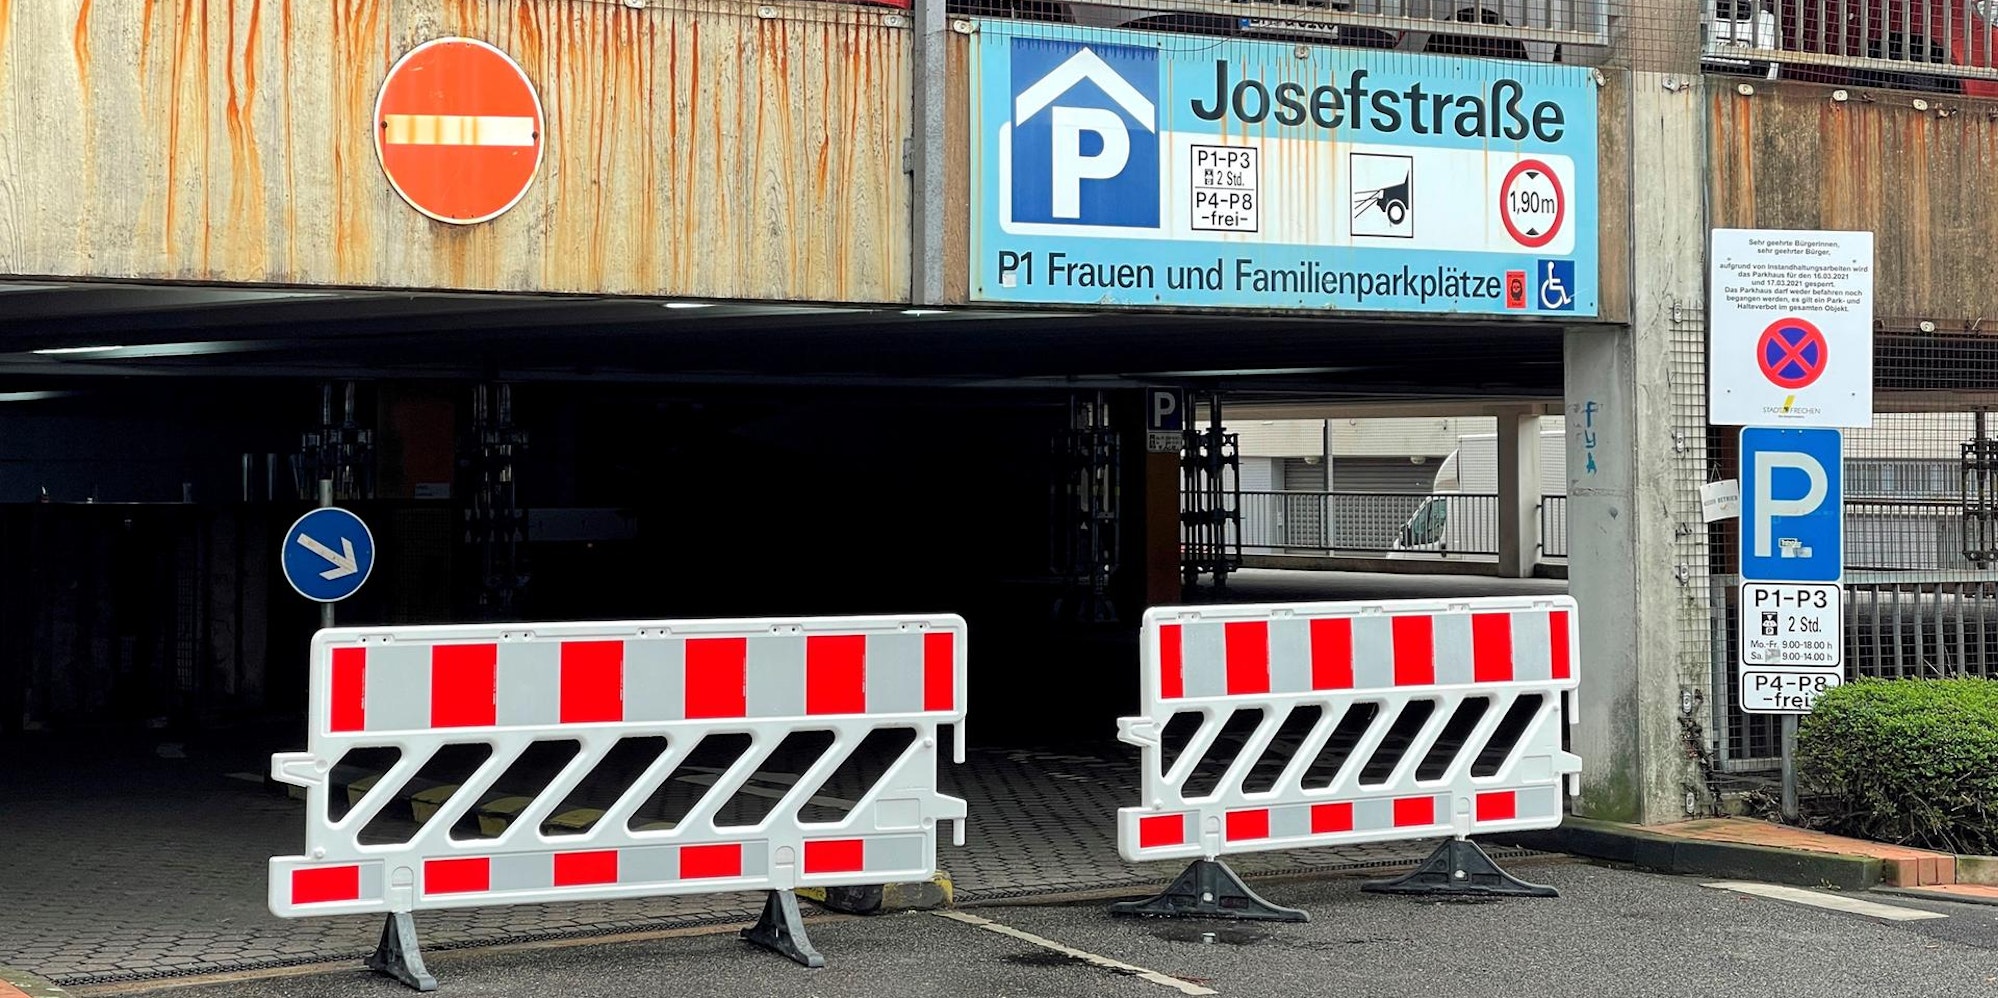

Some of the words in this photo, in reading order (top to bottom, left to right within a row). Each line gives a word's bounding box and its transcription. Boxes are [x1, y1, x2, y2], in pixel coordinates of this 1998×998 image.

[1191, 59, 1565, 143] Josefstraße
[1051, 105, 1130, 219] P
[1198, 150, 1250, 169] P1-P3
[1217, 170, 1223, 185] 2
[1226, 171, 1245, 186] Std.
[1196, 192, 1252, 210] P4-P8
[1201, 210, 1248, 226] -frei-
[1766, 240, 1793, 248] geehrte
[1774, 248, 1804, 256] geehrter
[1720, 262, 1751, 270] aufgrund
[1768, 264, 1852, 272] Instandhaltungsarbeiten
[998, 250, 1033, 285] P1
[1048, 252, 1154, 288] Frauen
[1167, 258, 1223, 290] und
[1236, 258, 1502, 304] Familienparkplätze
[1798, 272, 1812, 280] den
[1726, 294, 1760, 302] begangen
[1800, 296, 1813, 304] gilt
[1812, 288, 1844, 296] befahren
[1789, 304, 1824, 312] gesamten
[1154, 391, 1176, 428] P
[1754, 450, 1829, 557] P
[1755, 589, 1828, 609] P1-P3
[1788, 616, 1796, 633] 2
[1800, 616, 1822, 633] Std.
[1782, 640, 1825, 650] 9.00-18.00
[1826, 642, 1833, 650] h
[1782, 652, 1825, 662] 9.00-14.00
[1826, 653, 1833, 662] h
[1756, 675, 1827, 693] P4-P8
